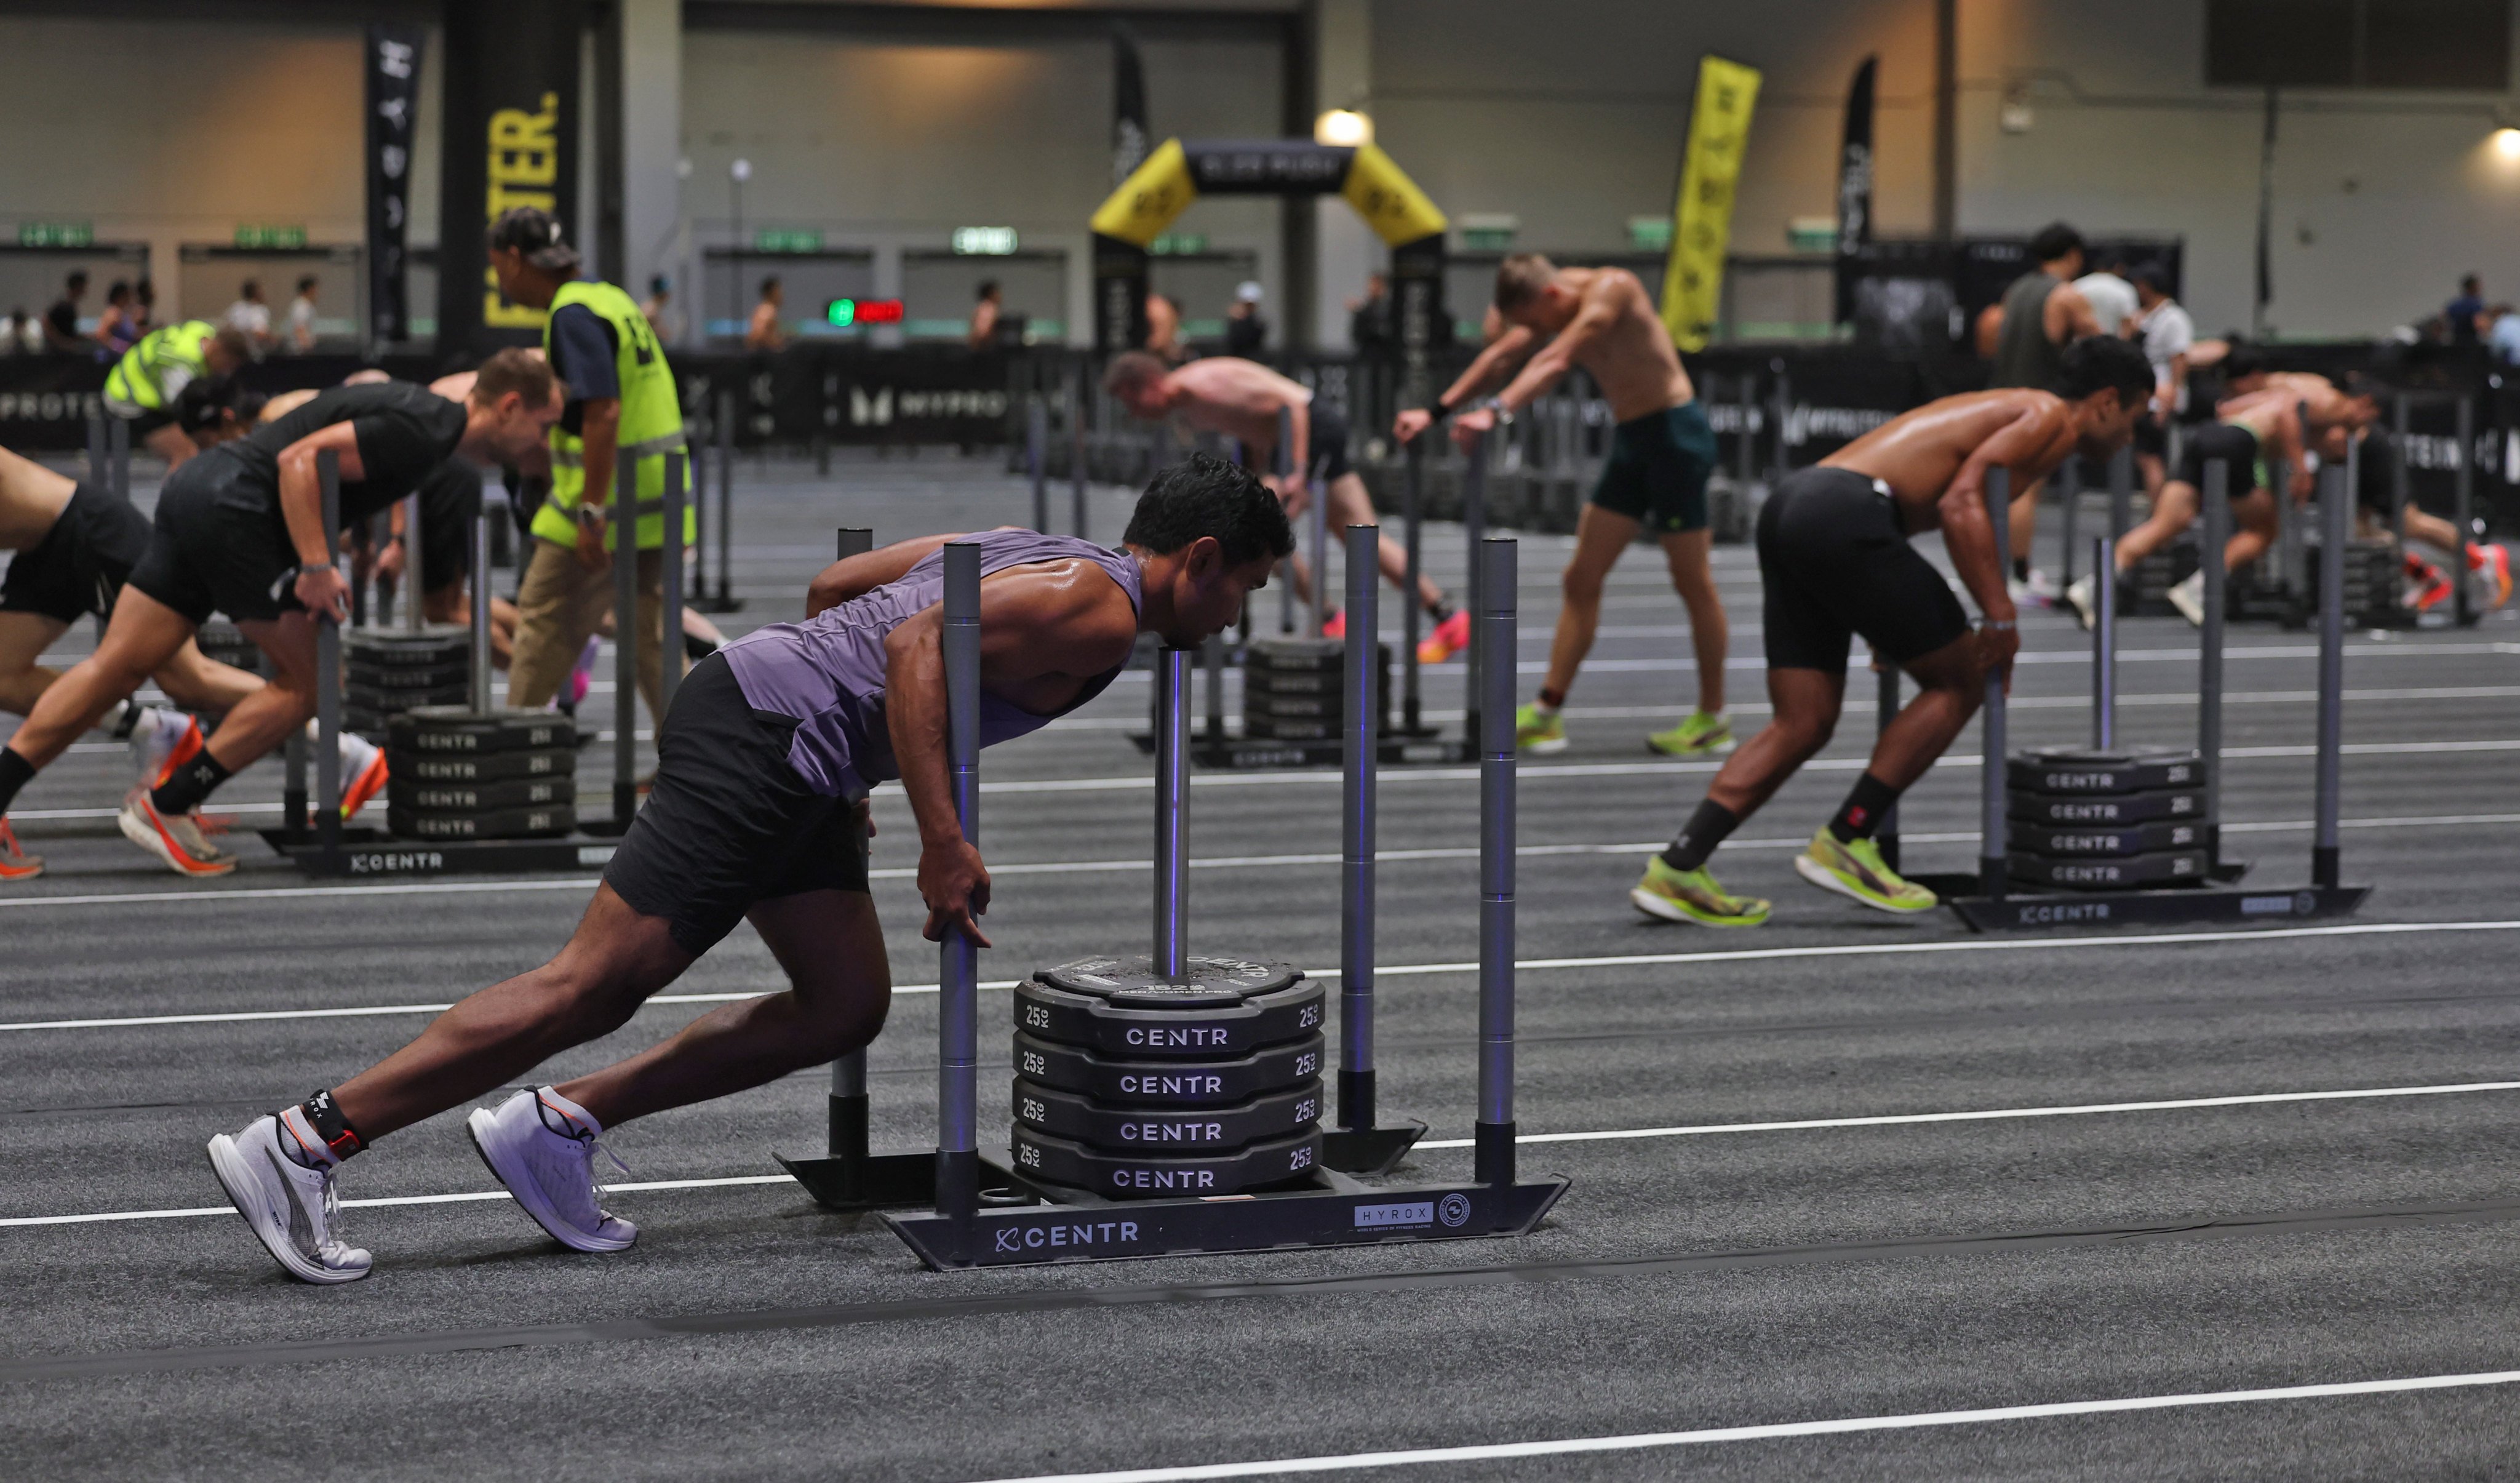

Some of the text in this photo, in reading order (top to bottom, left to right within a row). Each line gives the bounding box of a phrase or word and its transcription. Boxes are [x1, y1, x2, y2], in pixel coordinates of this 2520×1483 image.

[2046, 773, 2114, 788] CENTR
[2050, 804, 2118, 819] CENTR
[2051, 836, 2119, 850] CENTR
[2052, 866, 2120, 881] CENTR
[1026, 1005, 1048, 1028] 25 KG
[1299, 1006, 1313, 1027] 25
[1126, 1028, 1227, 1045] CENTR
[1024, 1051, 1044, 1075] 25 KG
[1296, 1053, 1310, 1076] 25
[1120, 1076, 1221, 1093] CENTR
[310, 1098, 322, 1119] ROX
[1023, 1098, 1044, 1122] 25 KG
[1295, 1100, 1309, 1122] 25
[1120, 1122, 1221, 1141] CENTR
[1021, 1143, 1040, 1168] 25 KG
[1290, 1148, 1306, 1170] 25
[1113, 1170, 1214, 1188] CENTR
[1363, 1208, 1425, 1221] HYROX
[1025, 1221, 1138, 1247] CENTR
